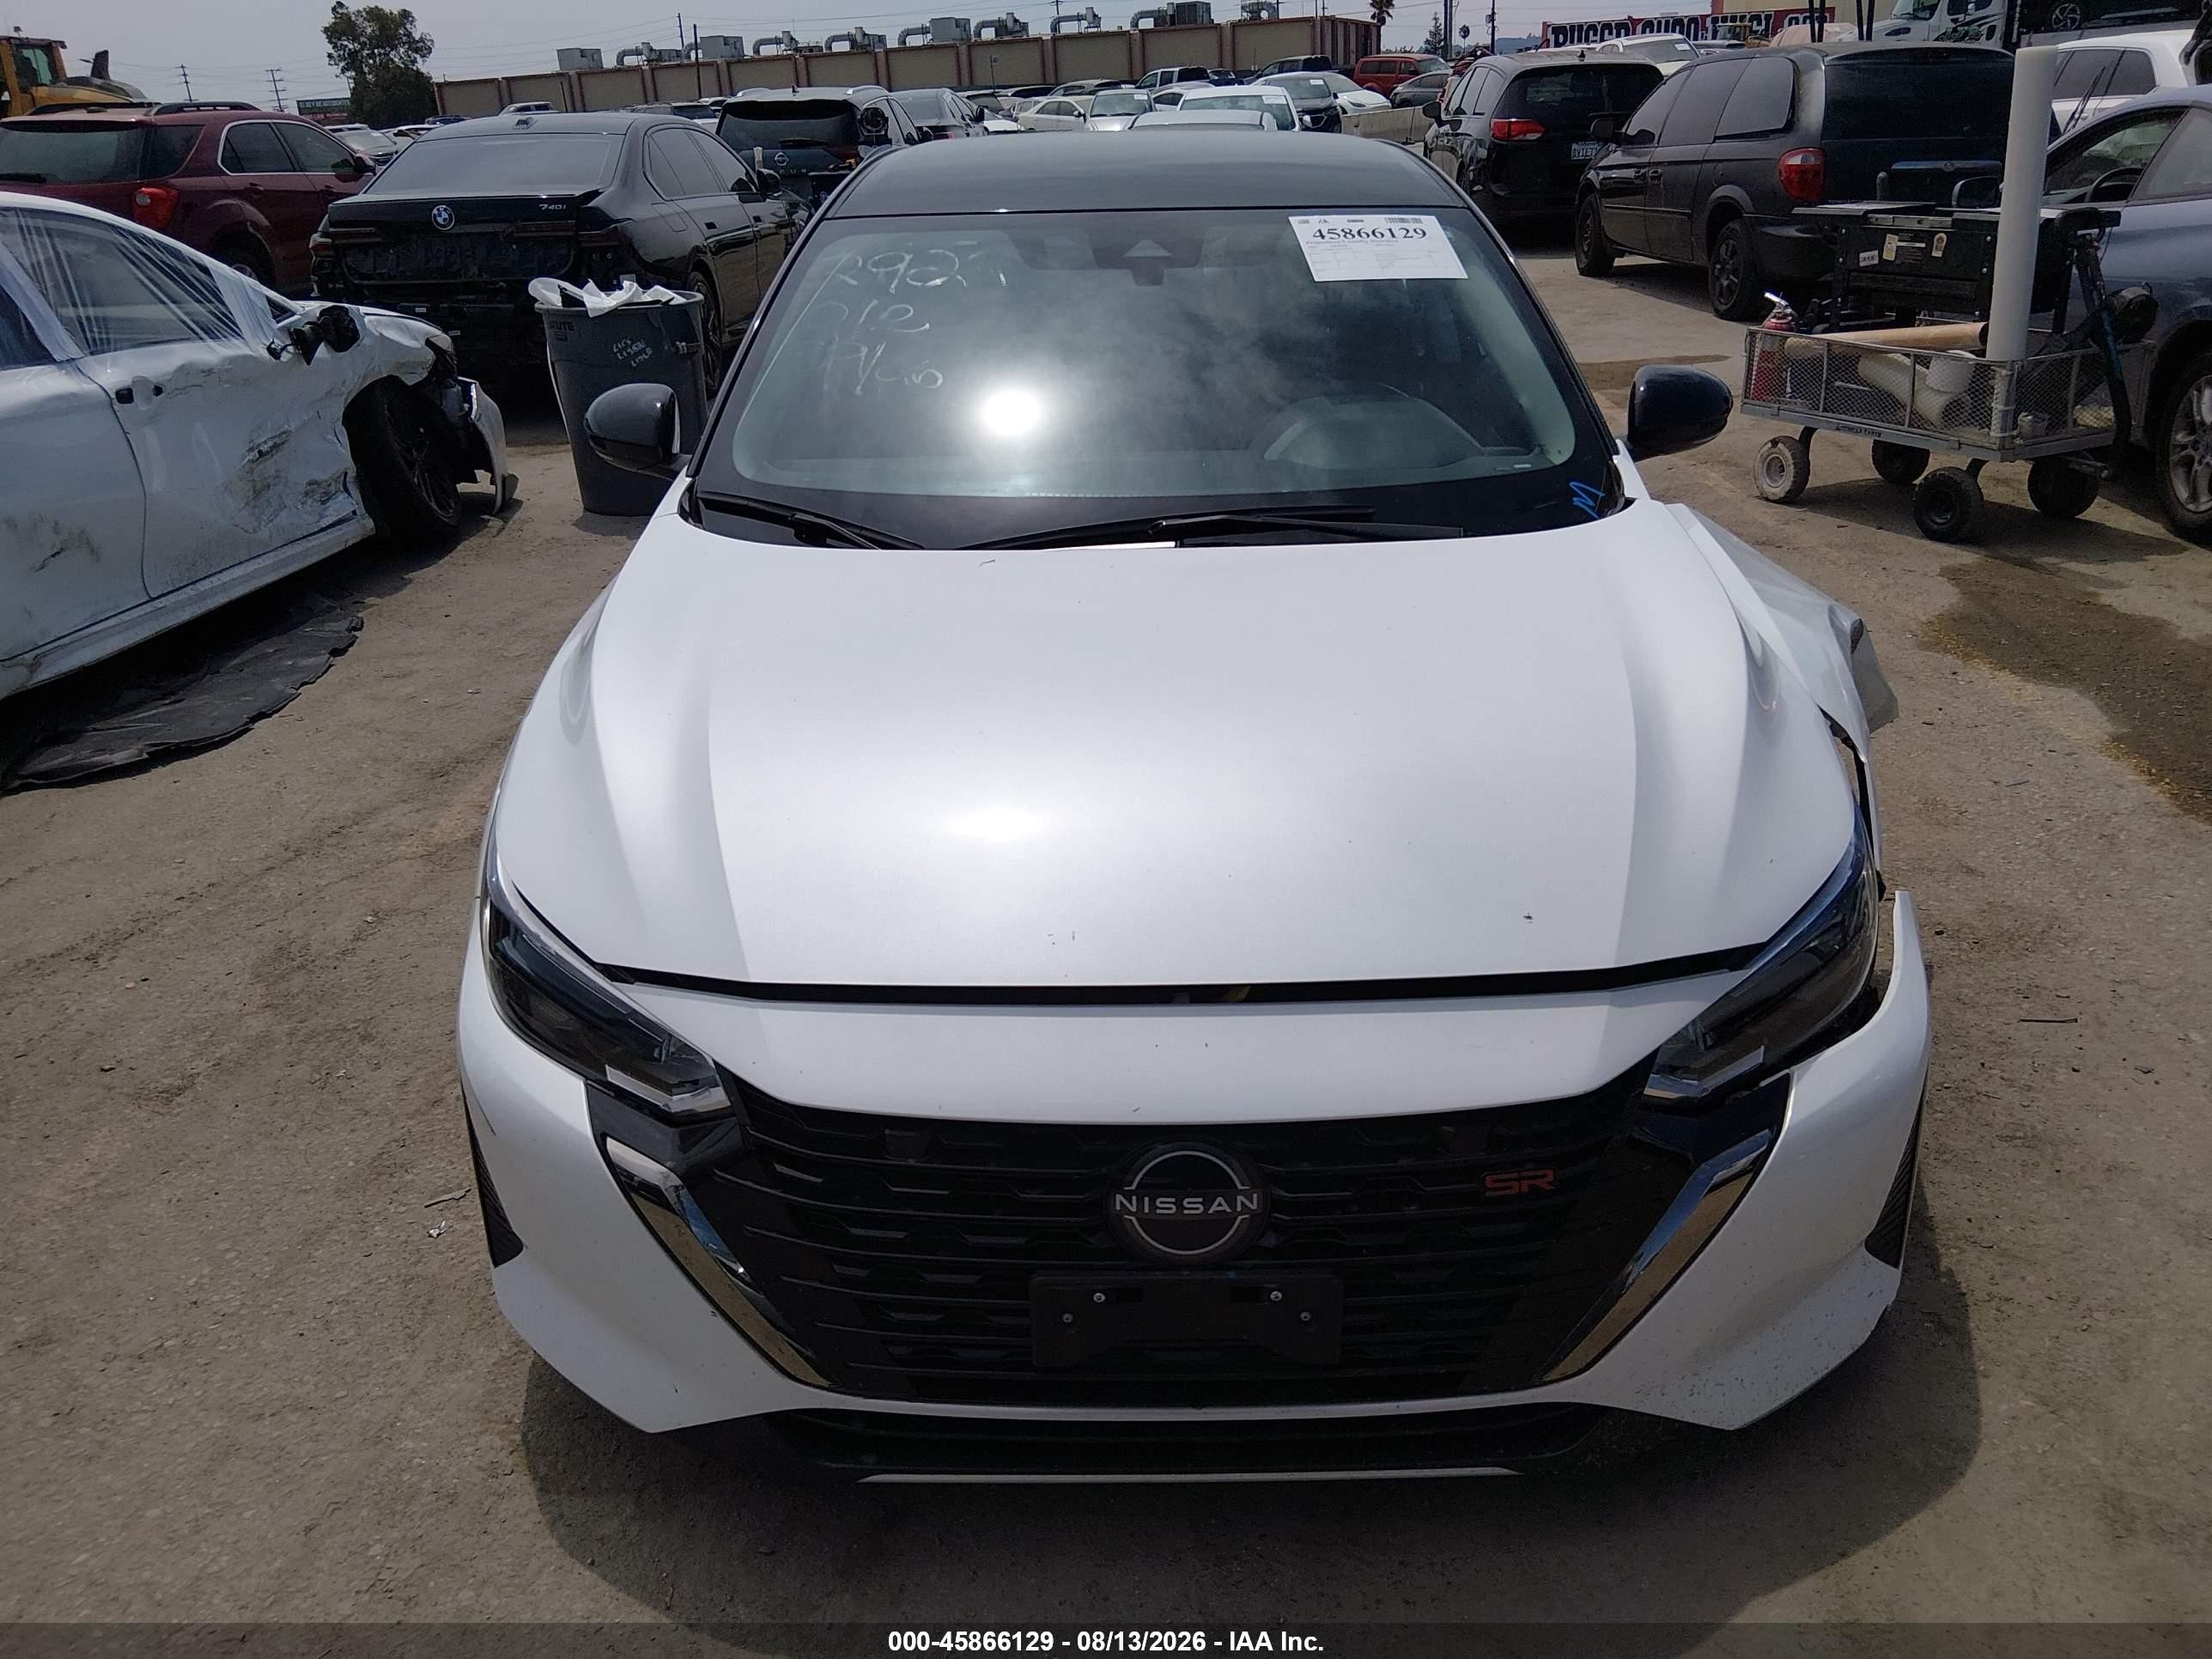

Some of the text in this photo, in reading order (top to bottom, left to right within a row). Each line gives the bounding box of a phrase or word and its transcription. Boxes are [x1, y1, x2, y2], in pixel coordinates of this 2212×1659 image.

[1312, 227, 1427, 240] 45866129
[1485, 1170, 1556, 1197] SR
[1115, 1193, 1259, 1215] NISSAN
